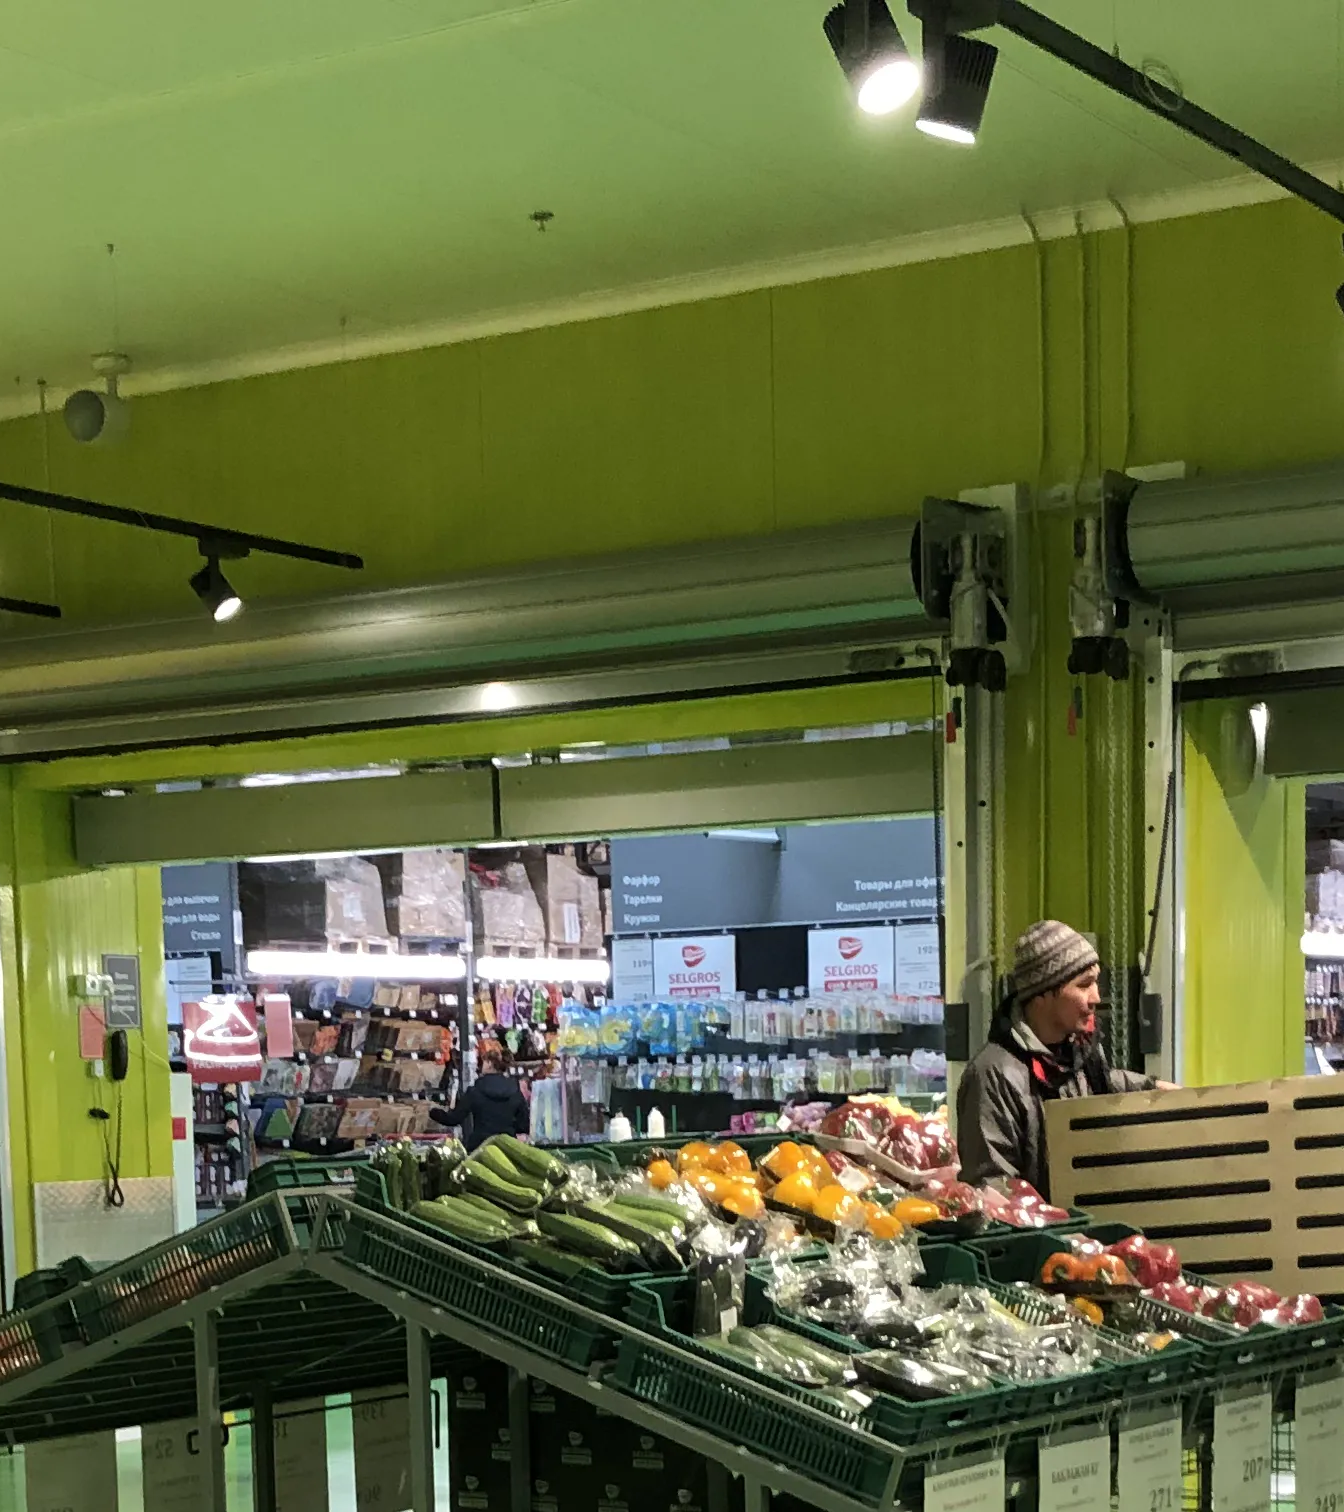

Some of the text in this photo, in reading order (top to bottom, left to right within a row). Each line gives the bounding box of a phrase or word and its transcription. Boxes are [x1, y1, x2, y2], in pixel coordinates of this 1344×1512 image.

[623, 875, 660, 887] Фарфор
[854, 876, 944, 891] Товары для офи
[623, 894, 662, 907] Тарелки
[836, 898, 944, 912] Канцелярские товар
[824, 964, 878, 977] SELGROS
[669, 972, 720, 984] SELGROS
